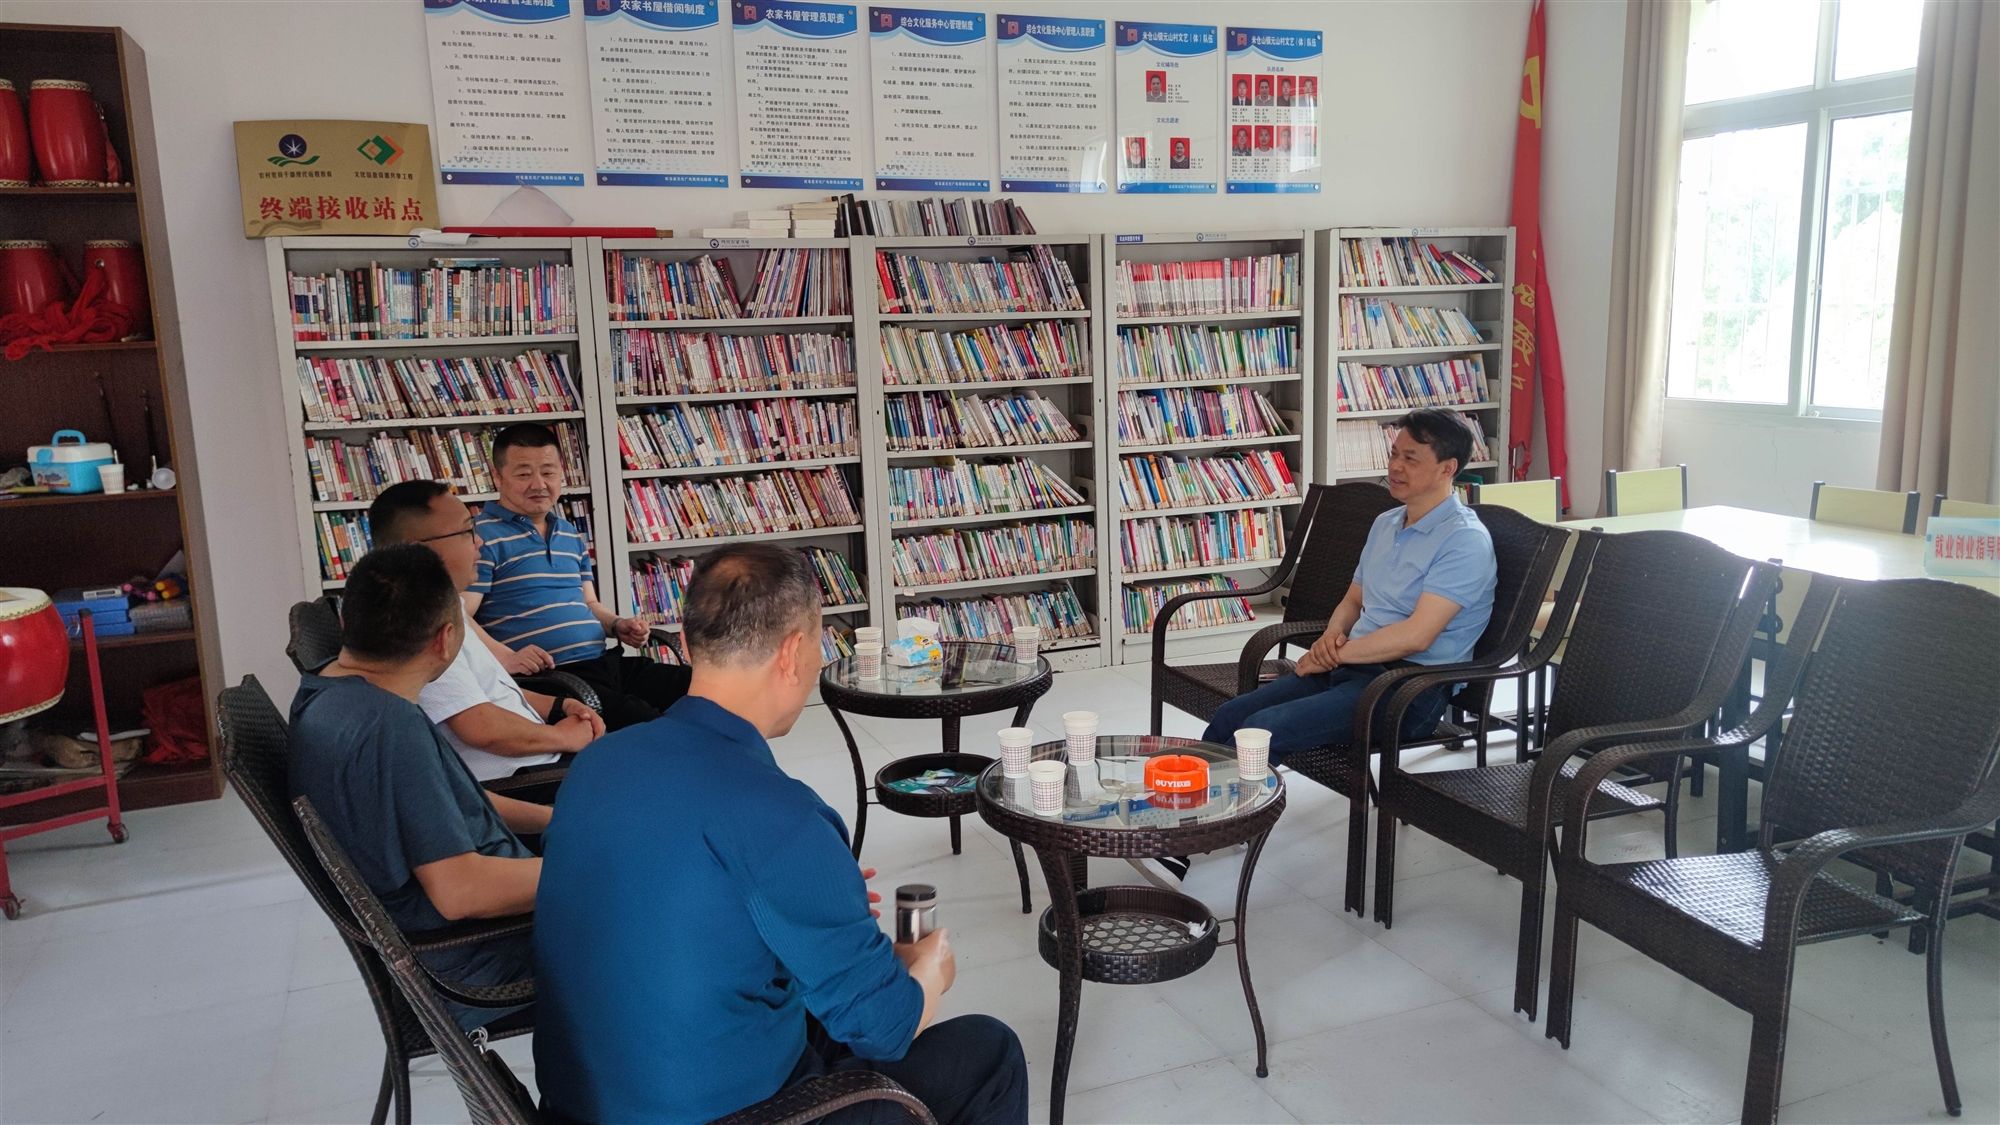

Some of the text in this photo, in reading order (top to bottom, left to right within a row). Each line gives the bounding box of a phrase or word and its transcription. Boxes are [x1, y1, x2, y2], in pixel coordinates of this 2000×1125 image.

[620, 0, 706, 16] 农家书屋借阅制度
[765, 8, 846, 24] 农家书屋管理员职责
[900, 16, 974, 31] 综合文化服务中心管理制度
[1025, 23, 1096, 38] 综合文化服务中心管理人员职责
[259, 195, 424, 221] 终端接收站点
